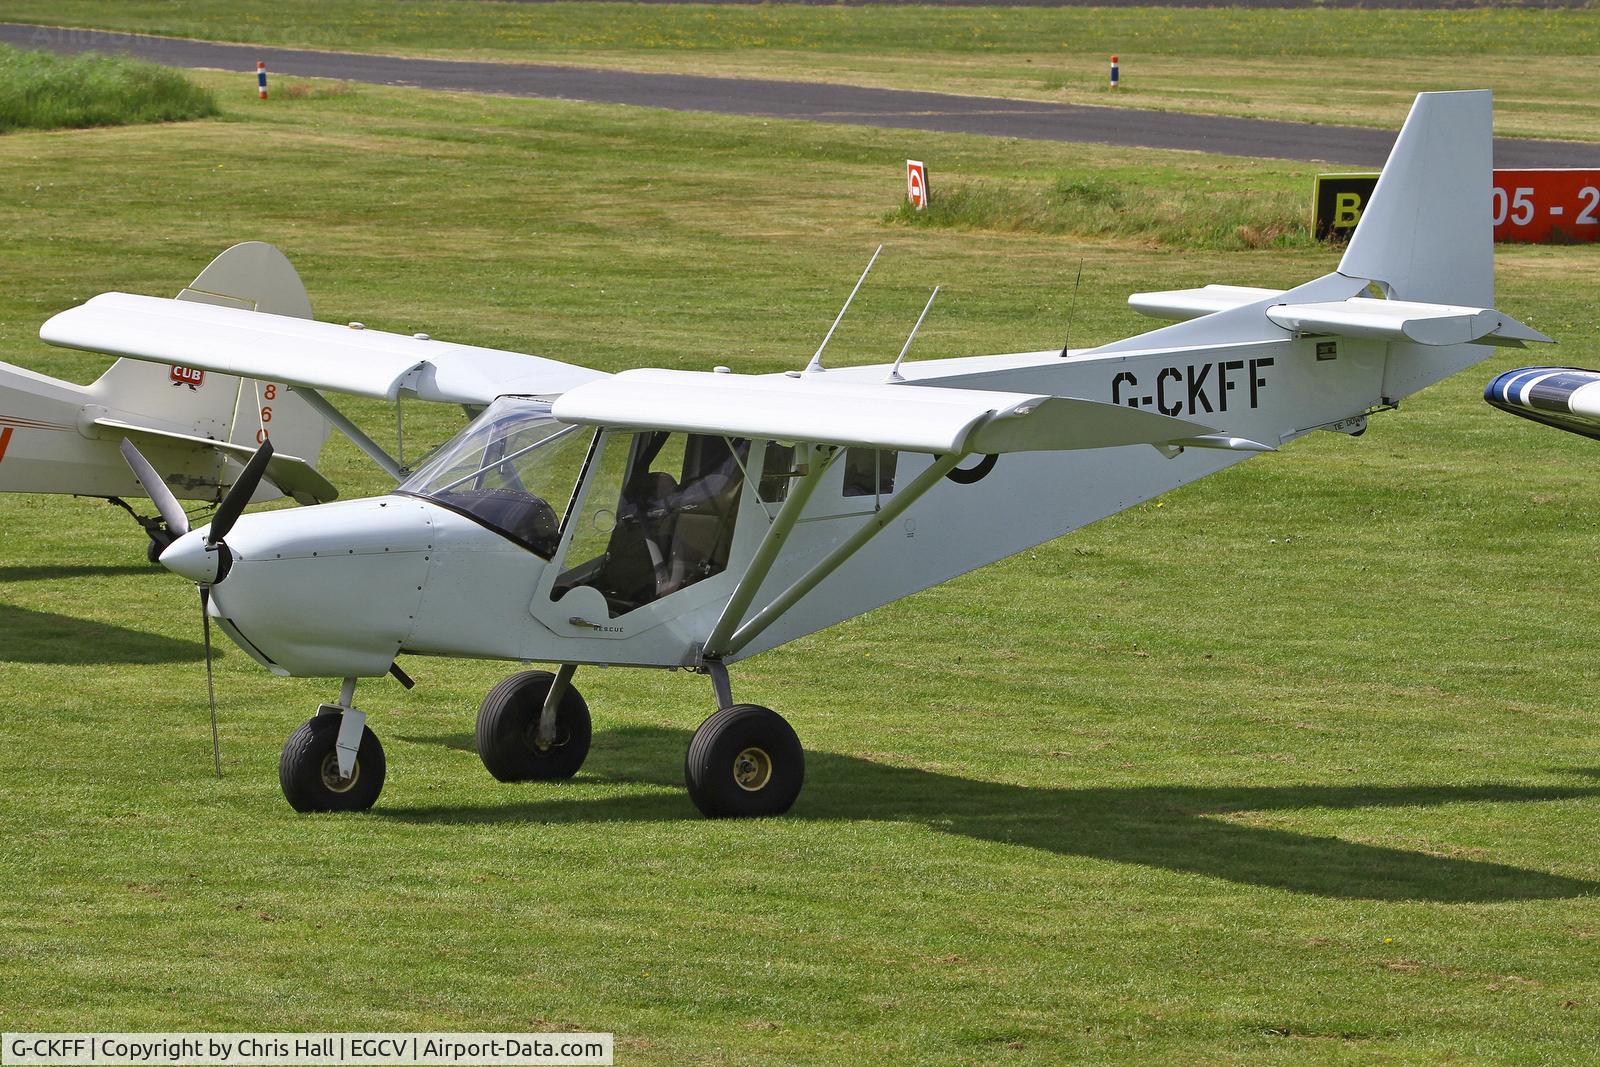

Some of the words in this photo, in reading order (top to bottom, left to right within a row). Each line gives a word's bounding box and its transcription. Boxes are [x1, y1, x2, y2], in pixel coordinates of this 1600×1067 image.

[1334, 192, 1361, 228] B
[1492, 187, 1534, 226] 05
[1575, 186, 1600, 225] 2
[173, 366, 201, 381] CUB
[1112, 357, 1275, 417] G-CKFF
